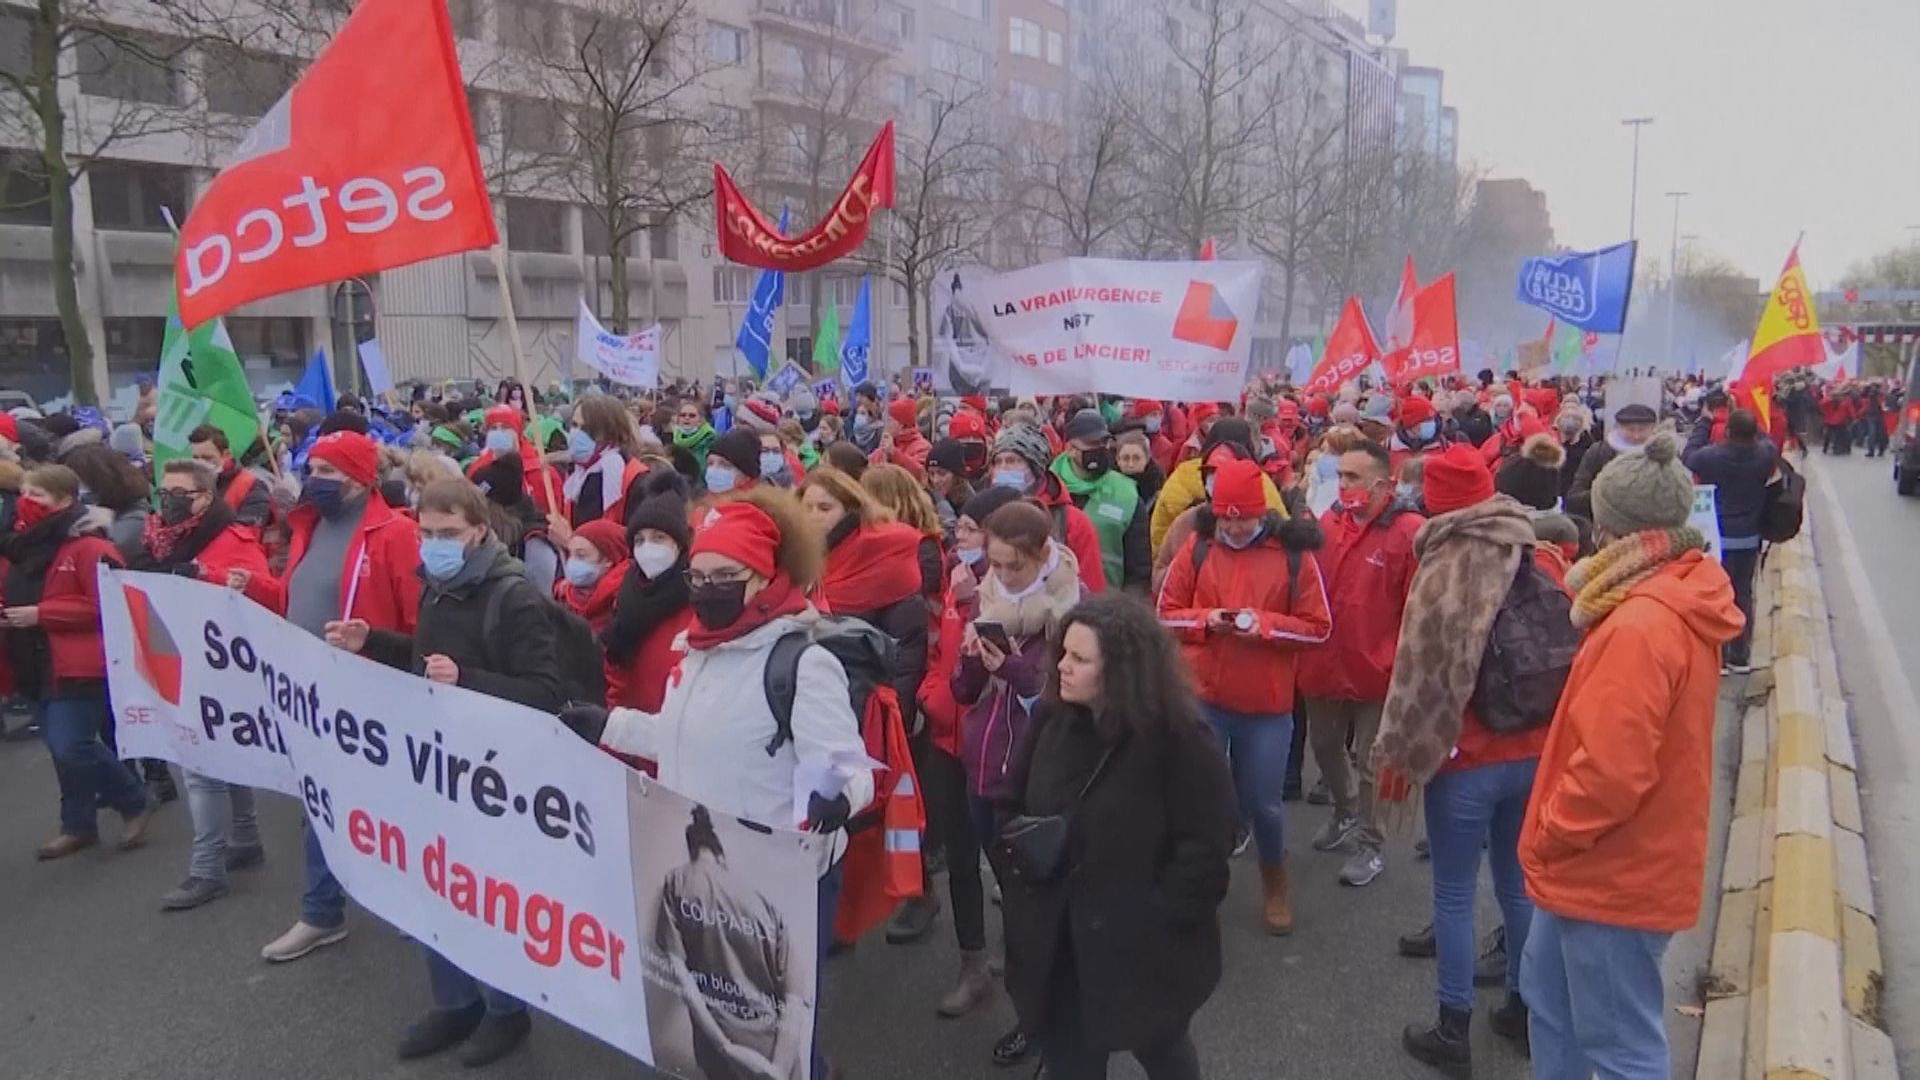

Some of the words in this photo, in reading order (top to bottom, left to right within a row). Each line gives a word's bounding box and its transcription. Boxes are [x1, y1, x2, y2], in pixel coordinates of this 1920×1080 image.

[993, 302, 1016, 317] LA
[1044, 348, 1067, 363] DE
[348, 808, 407, 874] en
[422, 836, 626, 983] danger
